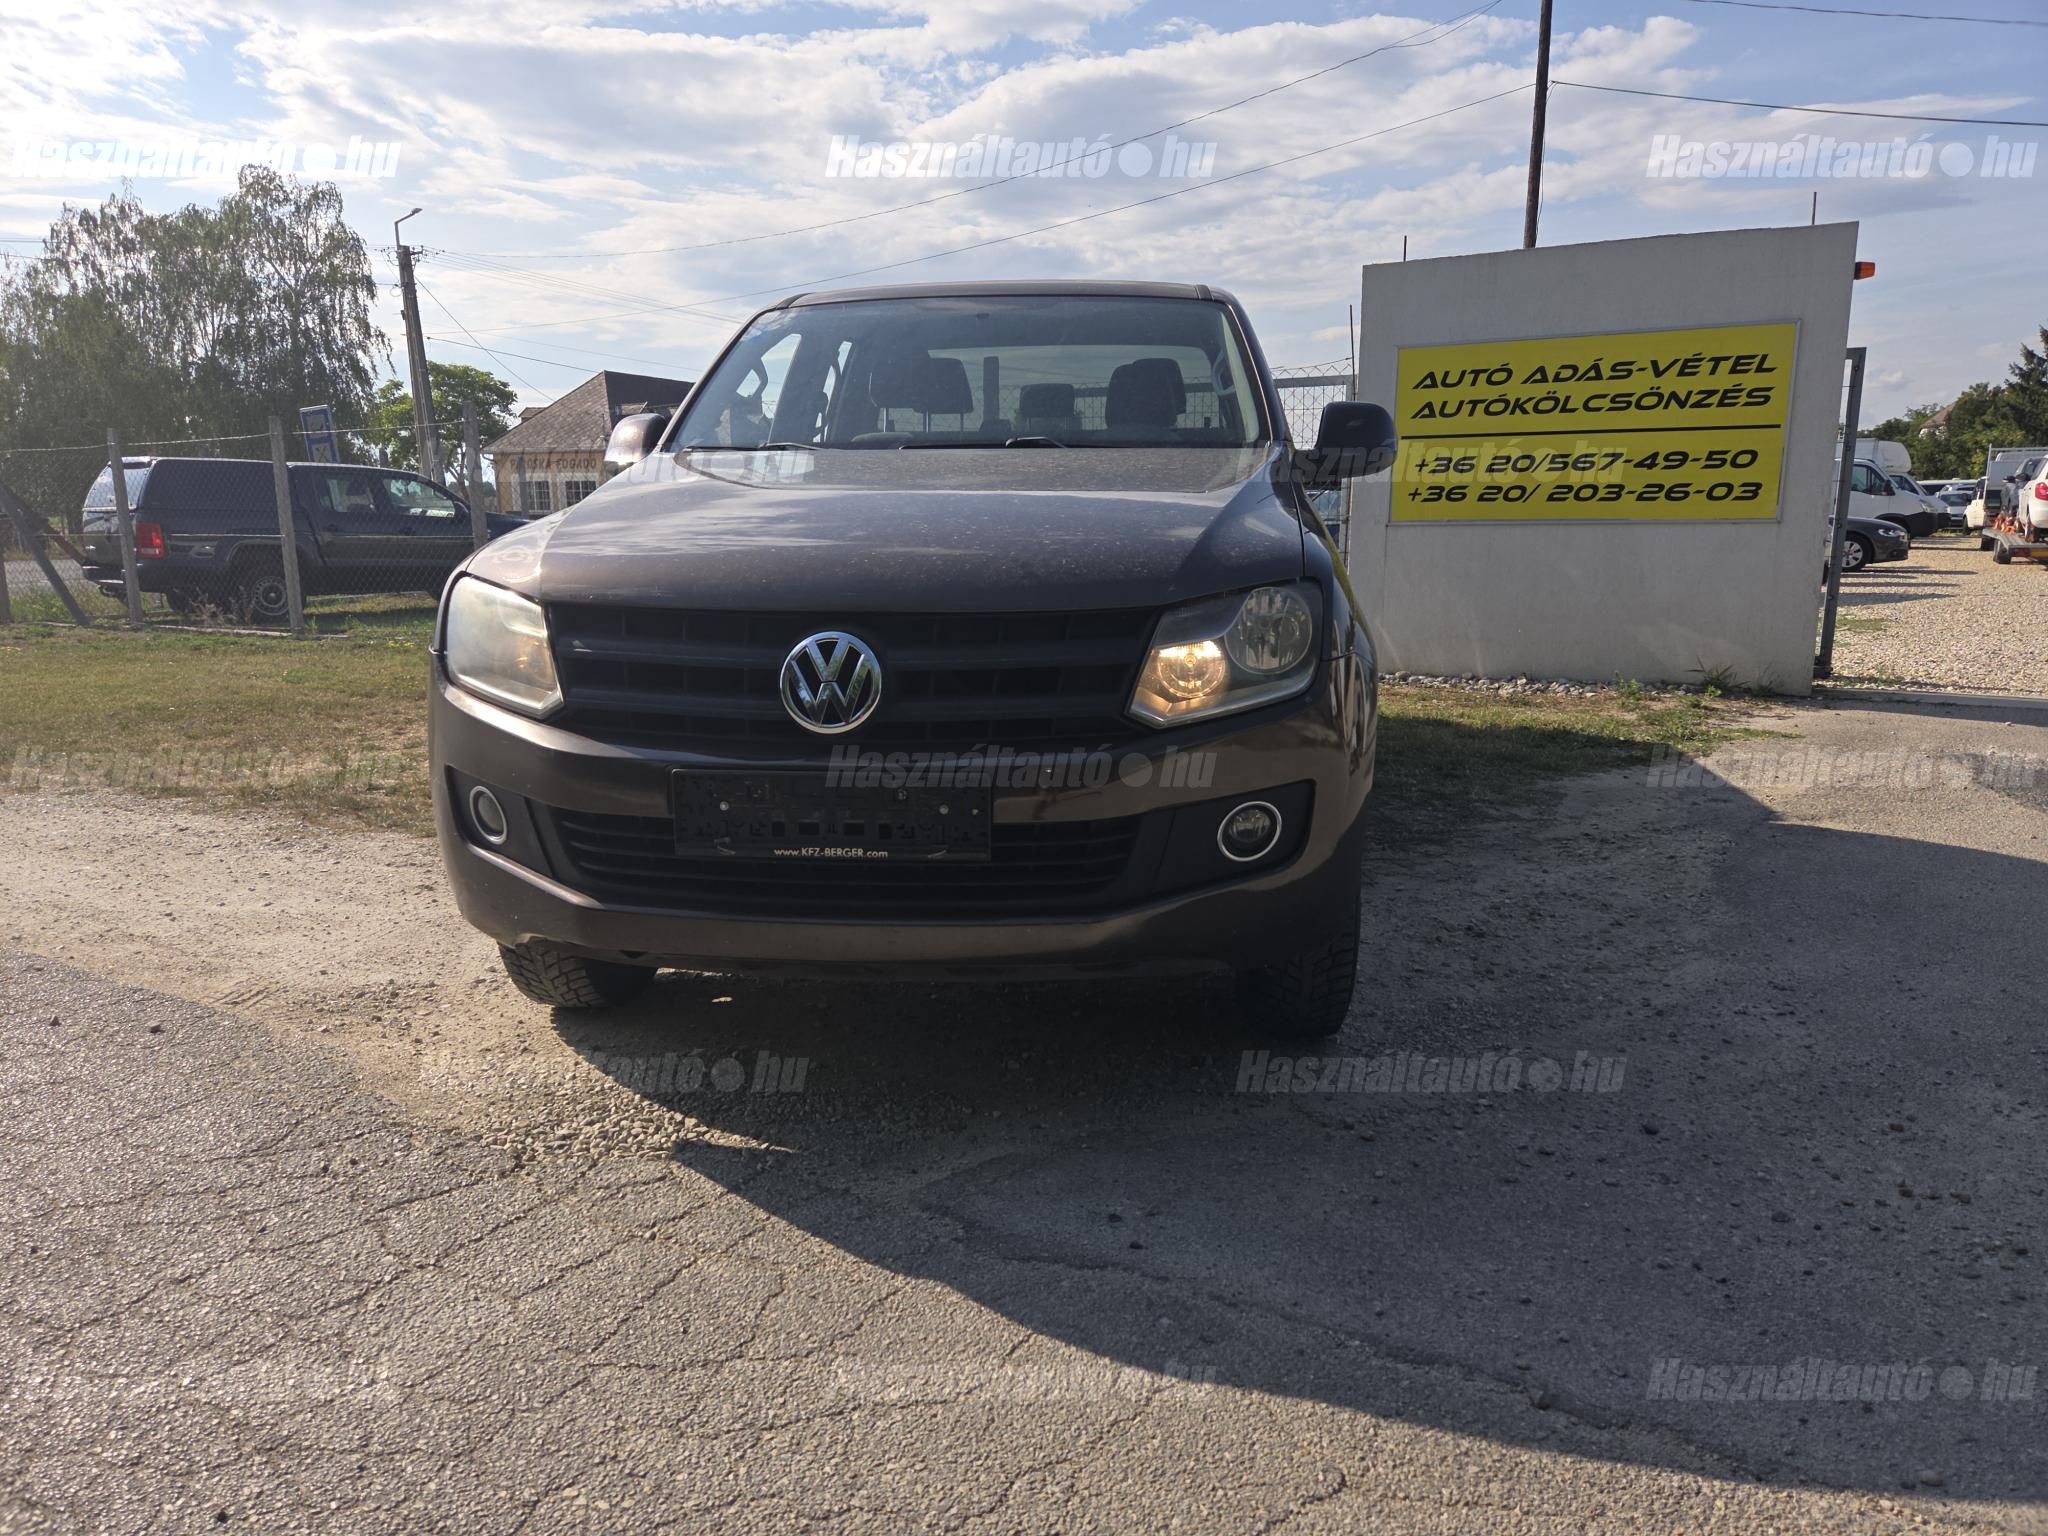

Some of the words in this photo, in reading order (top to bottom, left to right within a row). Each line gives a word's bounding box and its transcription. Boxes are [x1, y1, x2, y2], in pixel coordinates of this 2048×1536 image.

[1412, 363, 1513, 390] AUTÓ
[1520, 352, 1777, 385] ADÁS-VÉTEL
[1410, 383, 1776, 419] AUTÓKÖLCSÖNZÉS
[511, 458, 551, 470] POSKA
[1415, 455, 1478, 476] +36
[1485, 449, 1759, 474] 20/567-49-50
[1408, 485, 1470, 503] +36
[1477, 483, 1541, 503] 20/
[1546, 482, 1763, 503] 203-26-03
[774, 847, 888, 859] www.KFZ-BERGER.com
